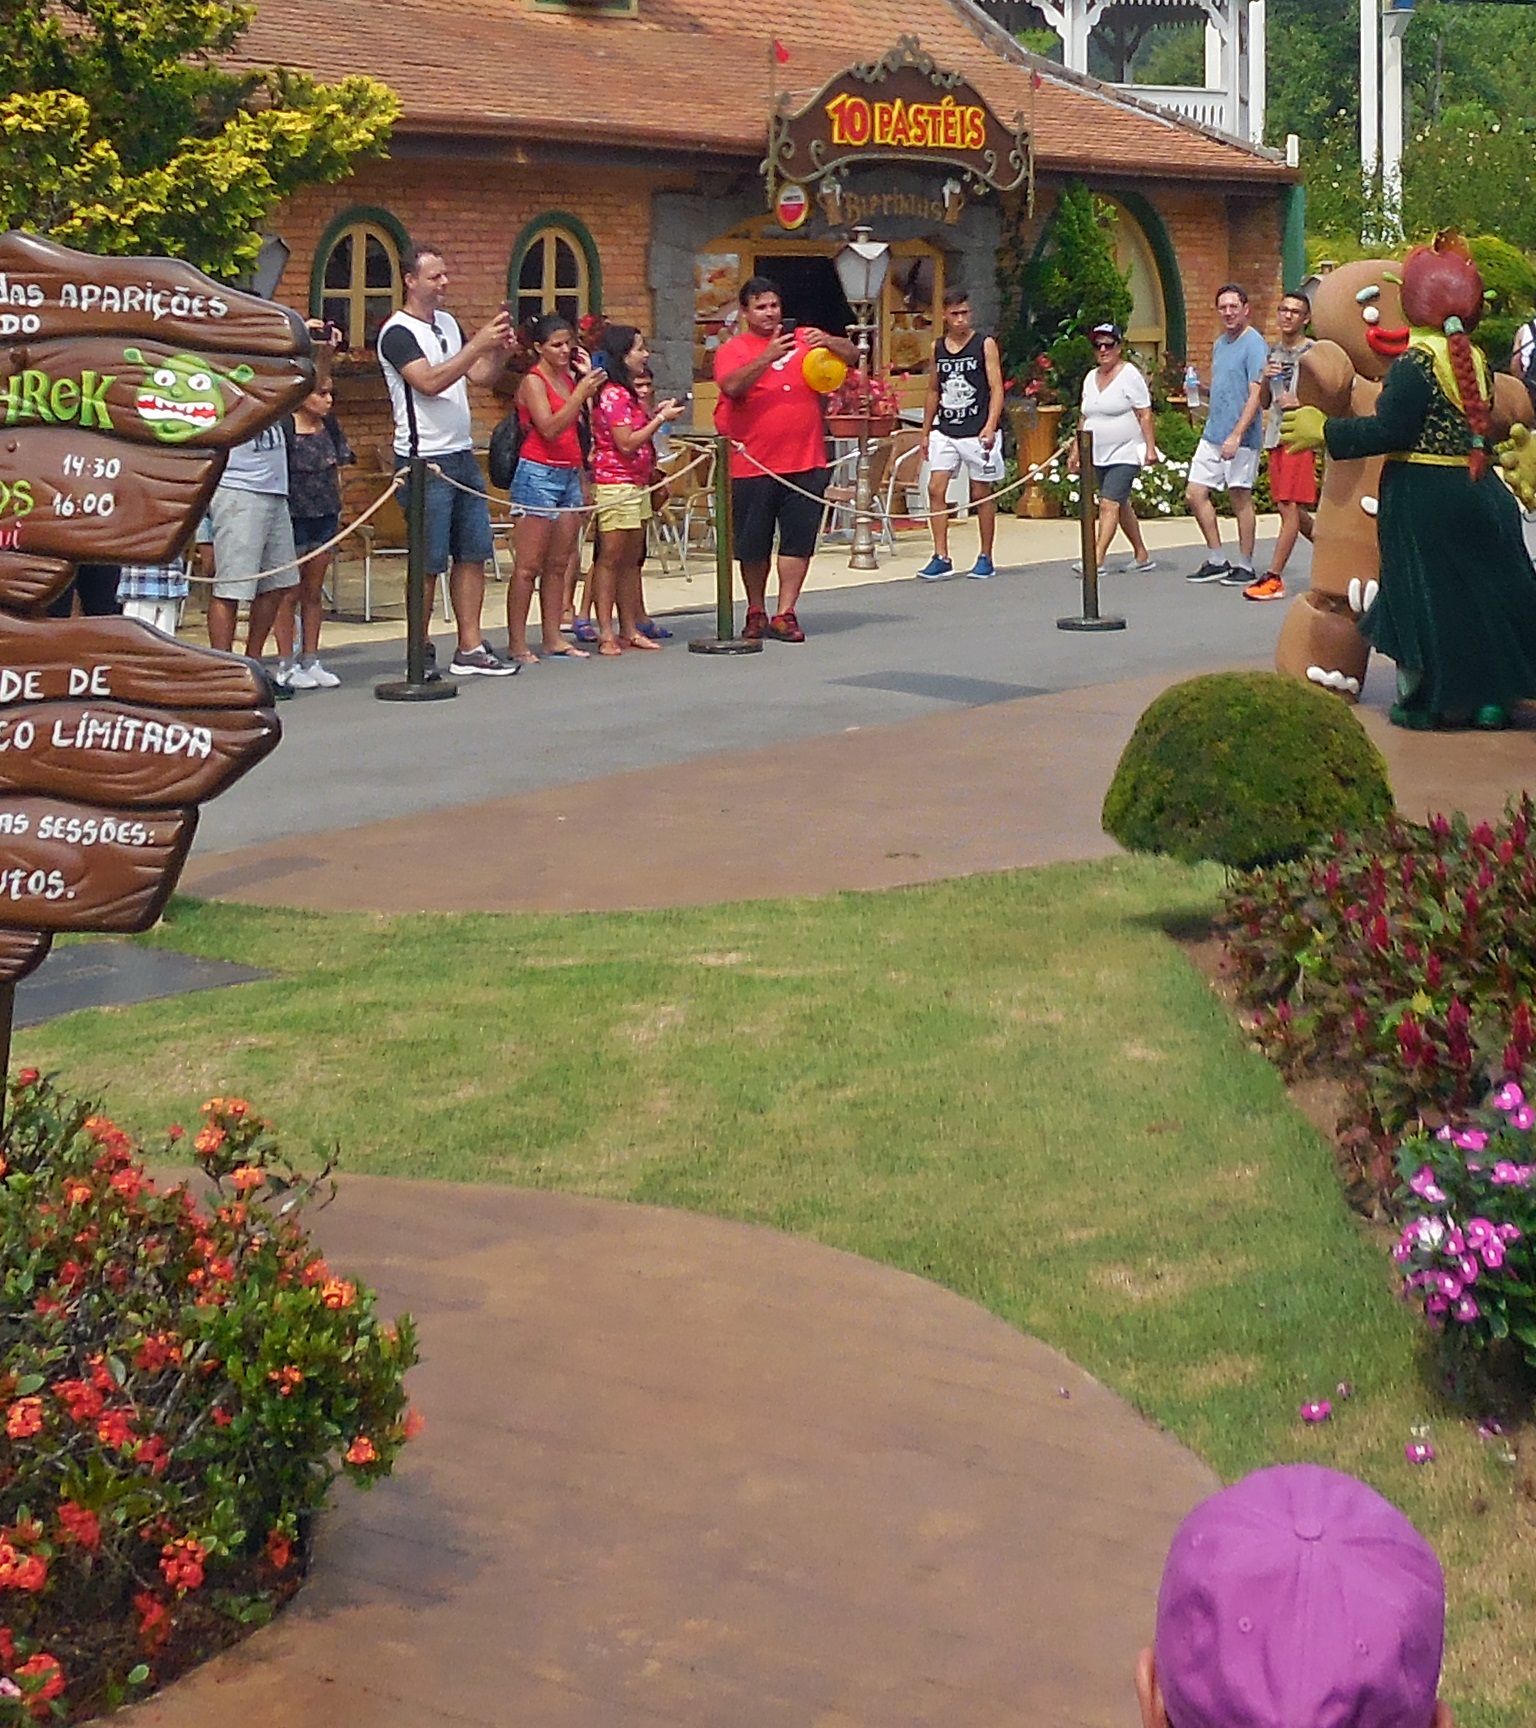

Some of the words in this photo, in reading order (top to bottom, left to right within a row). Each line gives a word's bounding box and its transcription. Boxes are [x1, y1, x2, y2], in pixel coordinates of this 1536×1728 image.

[825, 92, 871, 146] 10
[874, 95, 986, 151] PASTÉIS
[61, 453, 121, 480] 14:30
[51, 491, 116, 518] 16:00
[68, 665, 112, 696] DE
[51, 711, 212, 759] LIMITADA
[37, 815, 155, 845] SESSÕES:
